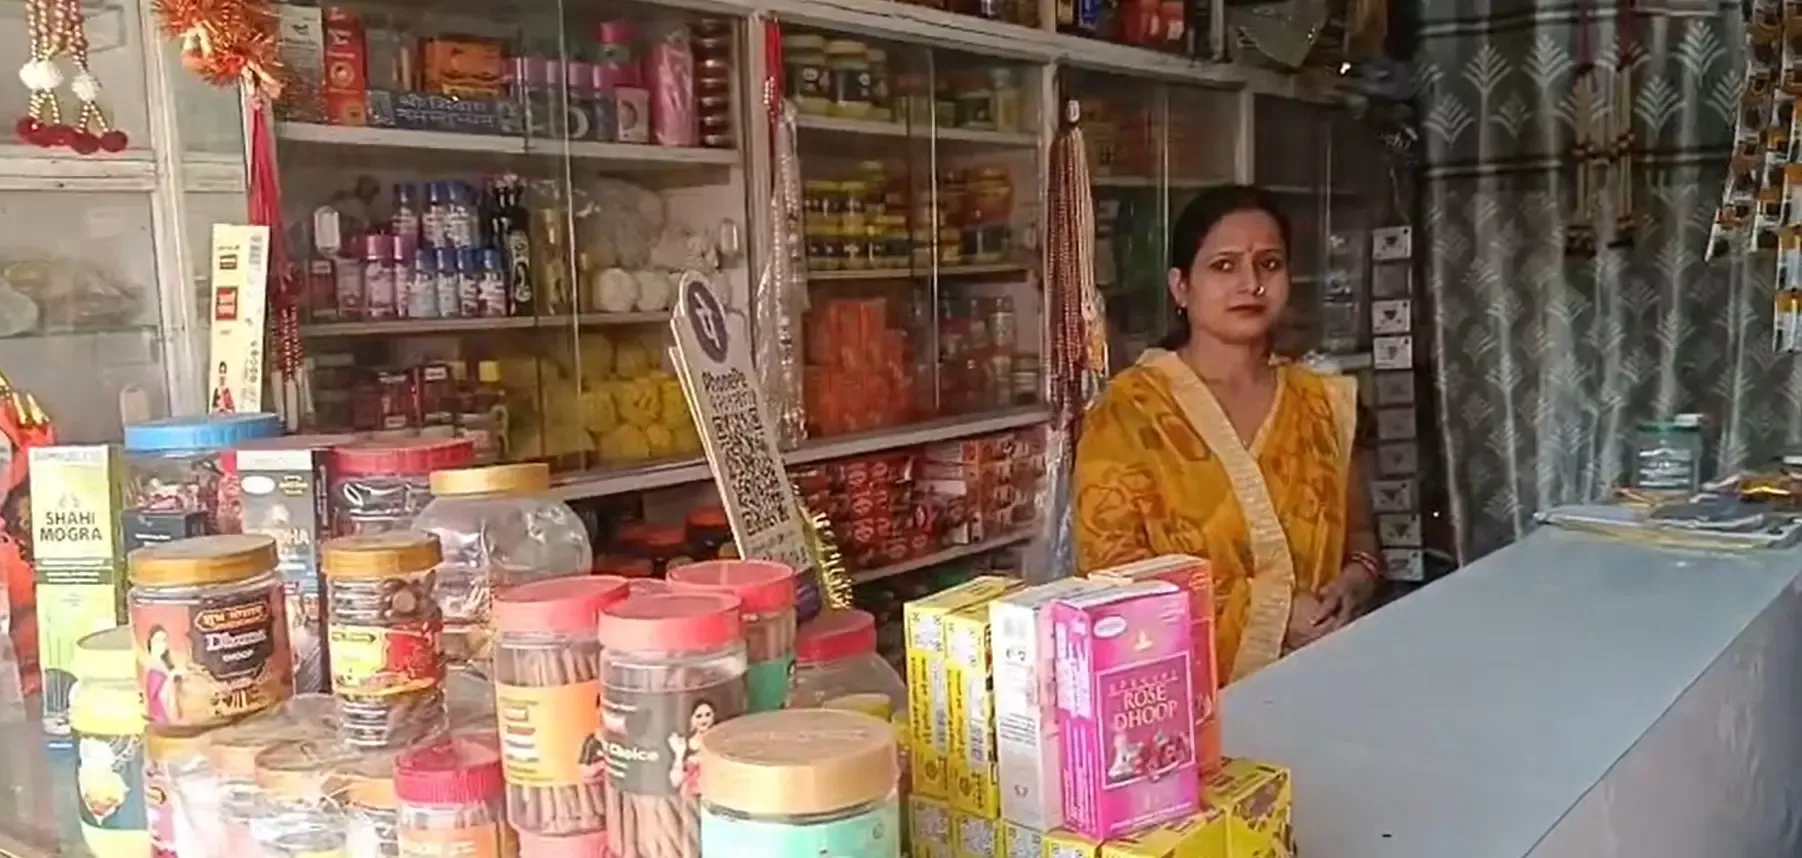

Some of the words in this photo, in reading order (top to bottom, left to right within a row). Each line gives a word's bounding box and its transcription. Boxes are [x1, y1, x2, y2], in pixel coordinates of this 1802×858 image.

[45, 511, 96, 525] SHAHI
[39, 527, 104, 541] MOGRA
[1123, 681, 1168, 711] ROSE
[1113, 699, 1179, 732] DHOOP
